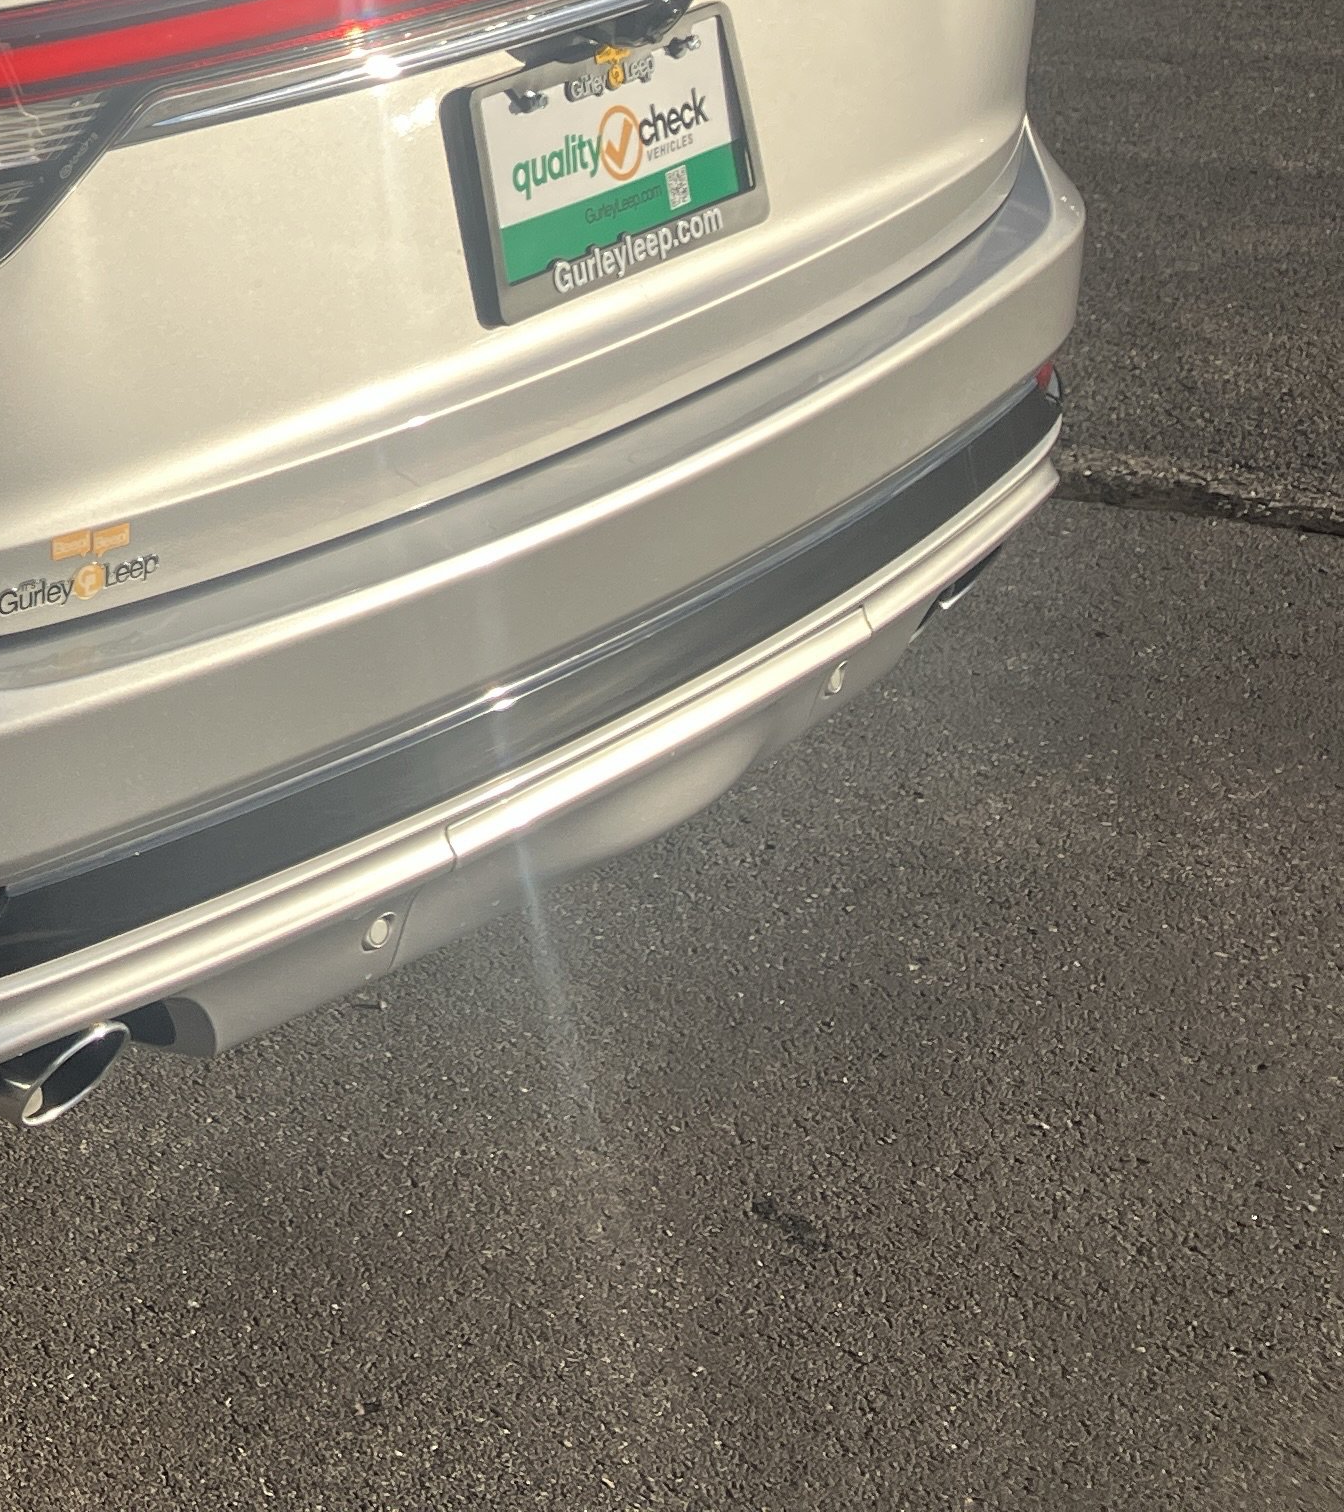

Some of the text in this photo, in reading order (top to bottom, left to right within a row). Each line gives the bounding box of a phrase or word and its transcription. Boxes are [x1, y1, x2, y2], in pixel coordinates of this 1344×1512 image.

[512, 88, 710, 200] quality check
[646, 133, 694, 162] VEHICLES
[585, 185, 662, 225] GurleyLeep.com
[553, 207, 724, 293] Gurleyleep.com
[104, 554, 159, 587] Leep
